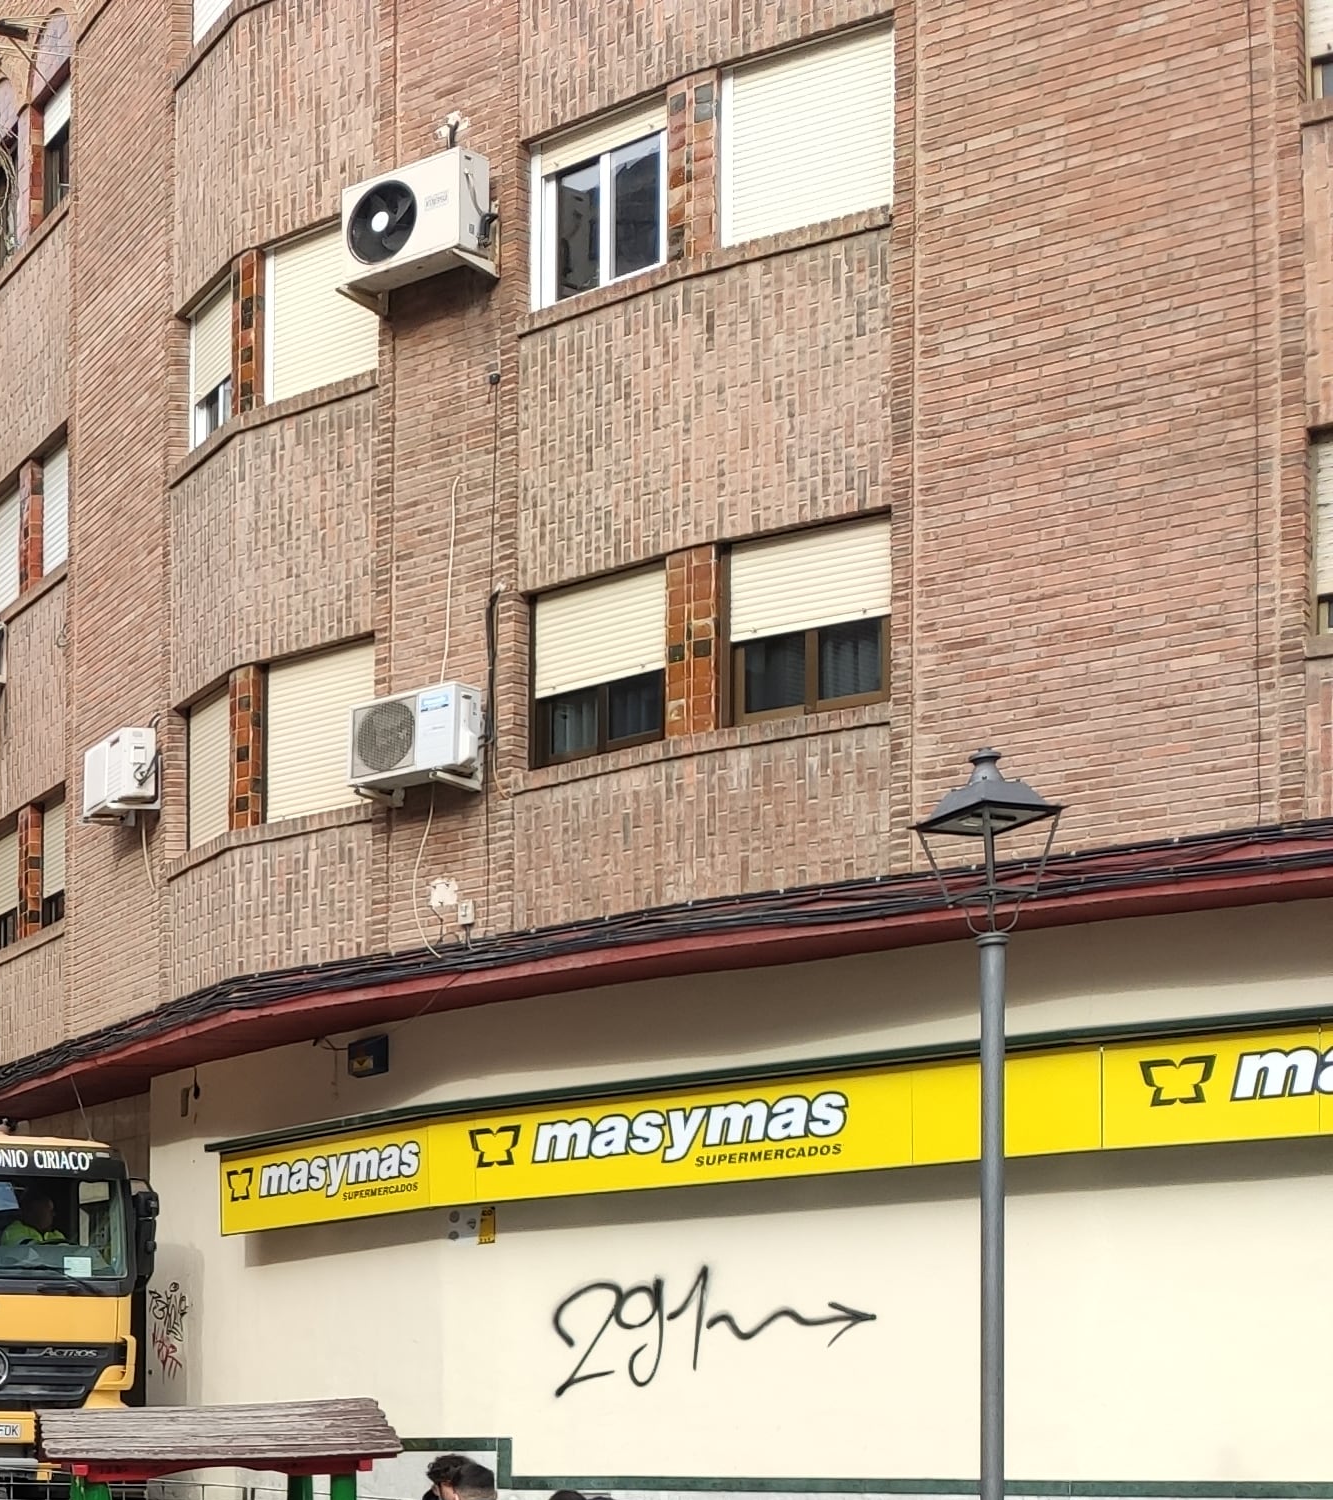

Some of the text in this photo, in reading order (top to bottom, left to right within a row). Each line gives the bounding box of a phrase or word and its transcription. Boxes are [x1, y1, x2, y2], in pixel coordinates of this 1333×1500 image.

[532, 1090, 849, 1165] masymas
[259, 1140, 421, 1199] masymas
[693, 1141, 844, 1168] SUPERMERCADOS
[341, 1181, 419, 1203] SUPERMERCADOS
